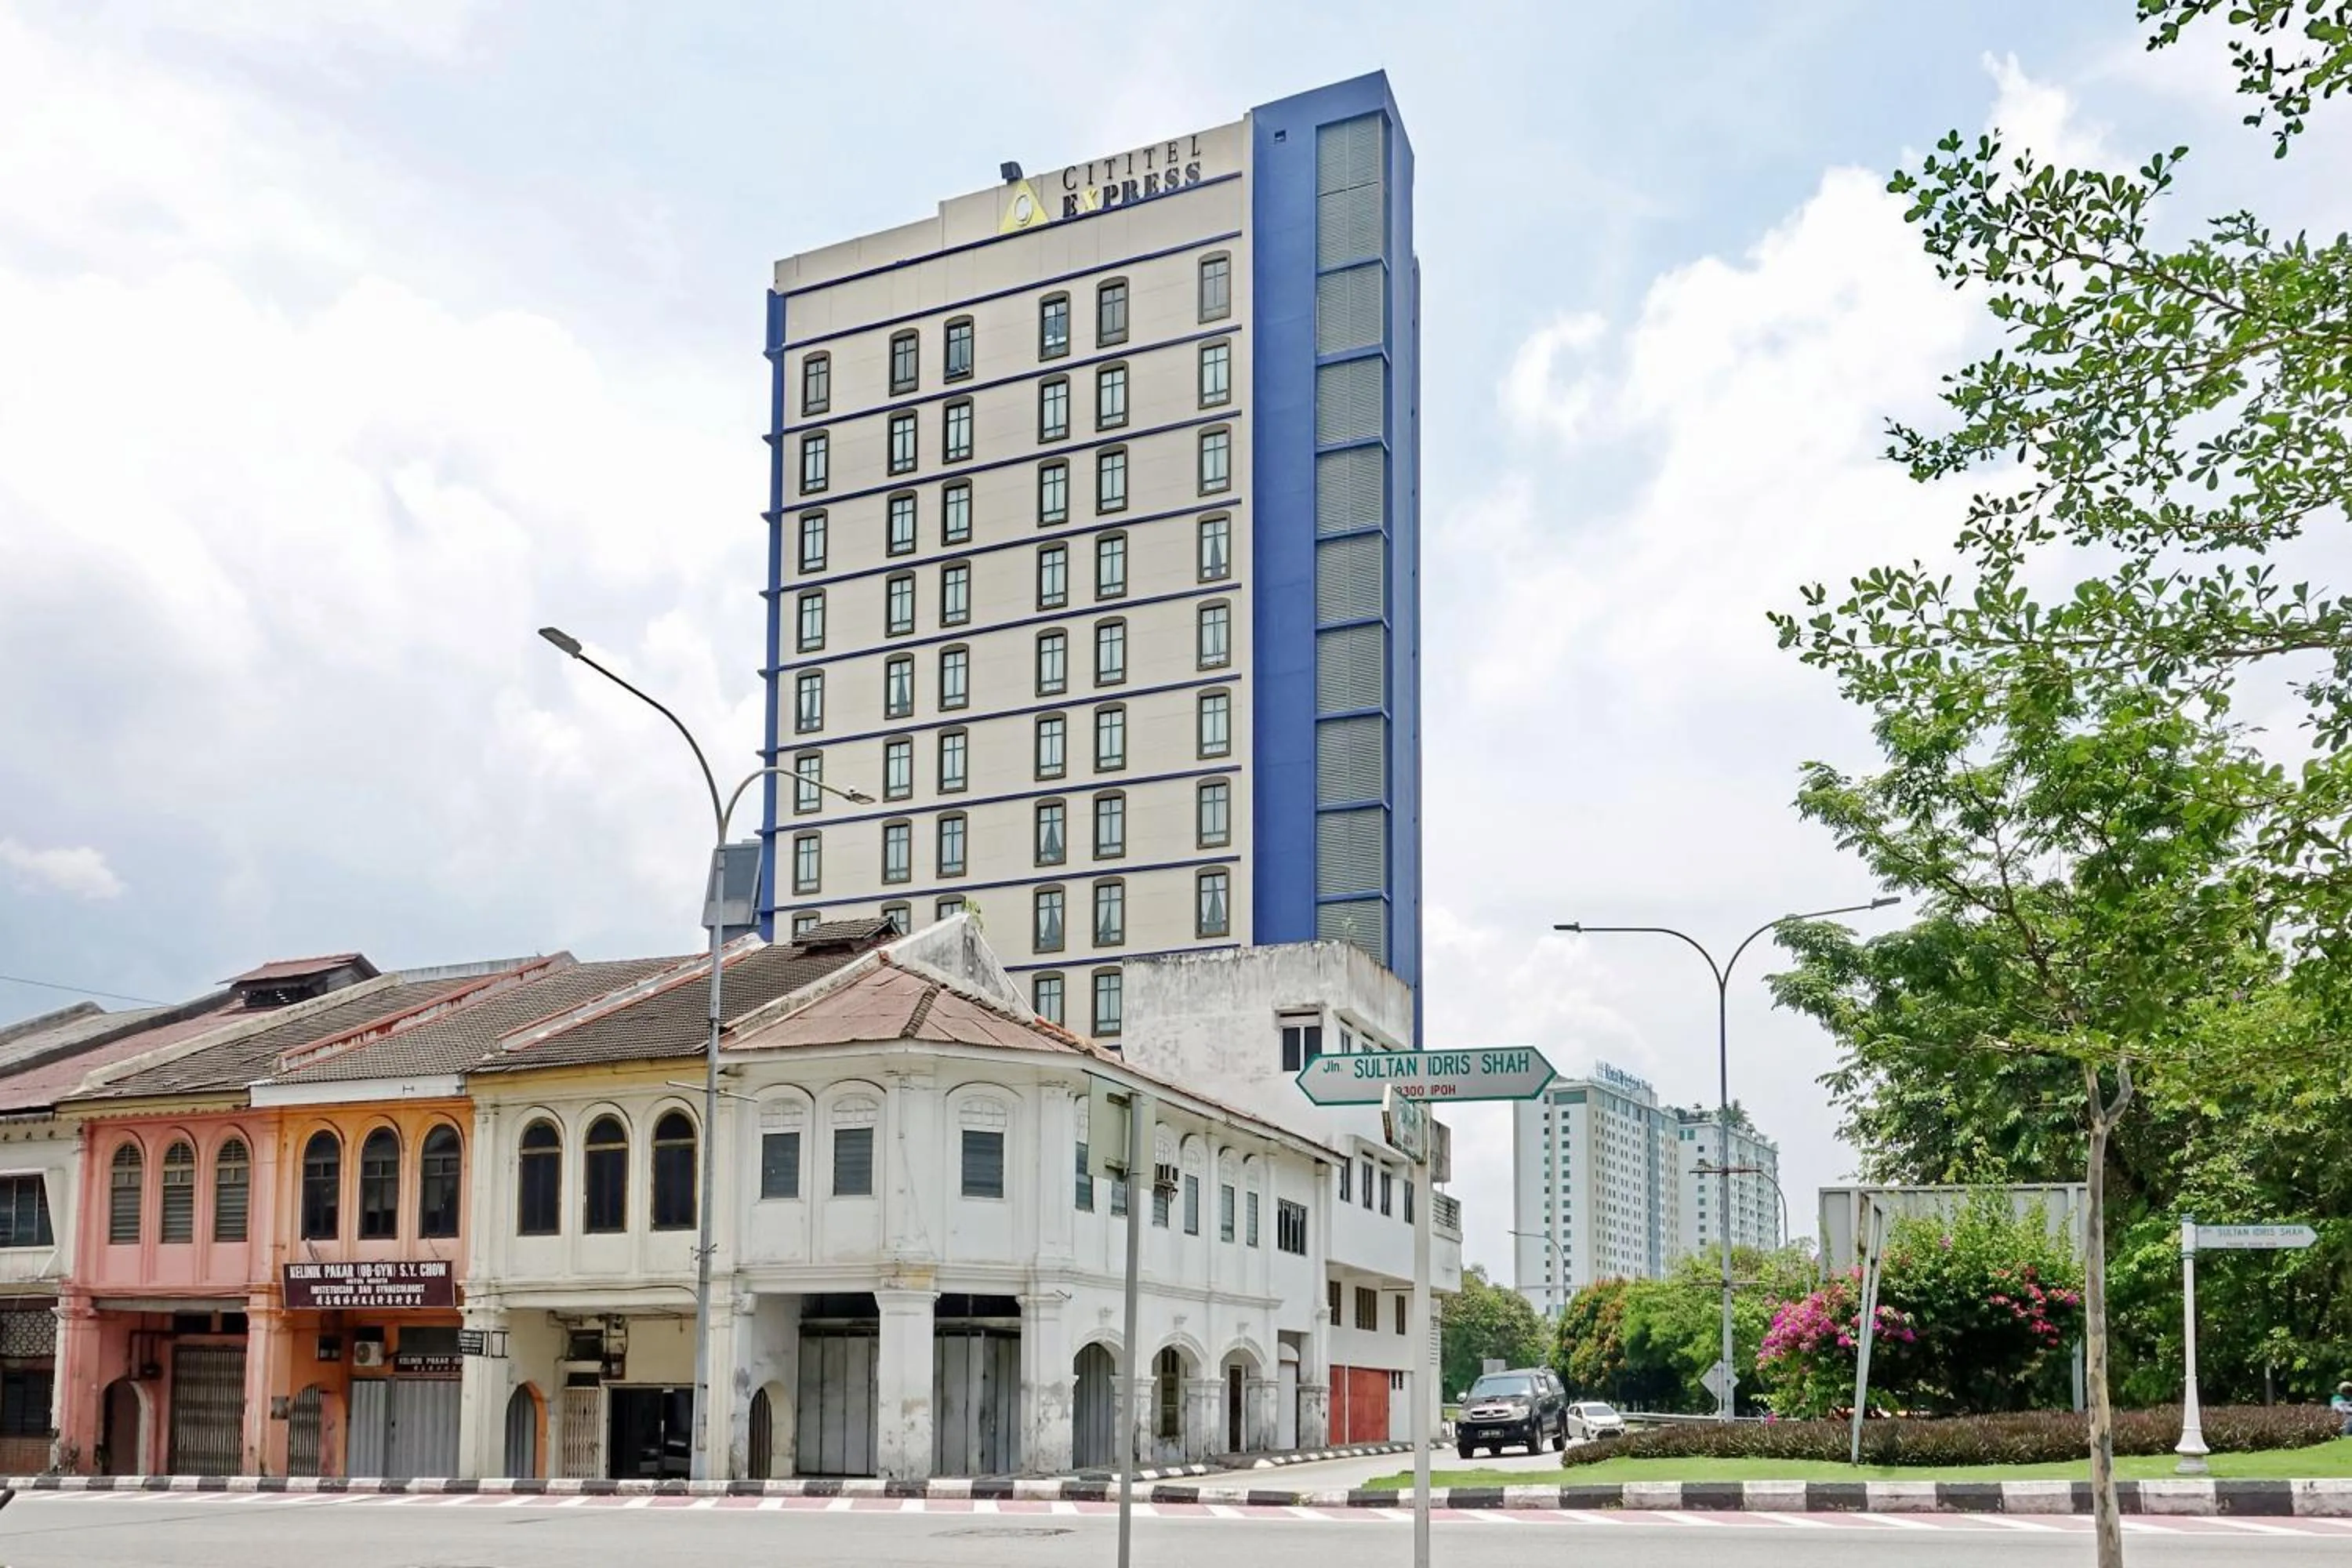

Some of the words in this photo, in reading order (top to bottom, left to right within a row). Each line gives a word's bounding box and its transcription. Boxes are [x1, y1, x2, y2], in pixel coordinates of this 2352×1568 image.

[1063, 136, 1201, 191] CITITEL
[1063, 162, 1201, 218] EXPRESS
[1323, 1061, 1342, 1073] Jln.
[1354, 1056, 1417, 1079] SULTAN
[1427, 1054, 1471, 1076] IDRIS
[1481, 1053, 1530, 1075] SHAH
[1431, 1084, 1456, 1096] IPOH
[289, 1265, 321, 1279] KELINIK
[324, 1264, 354, 1278] PAKAR
[419, 1262, 446, 1277] CHOW
